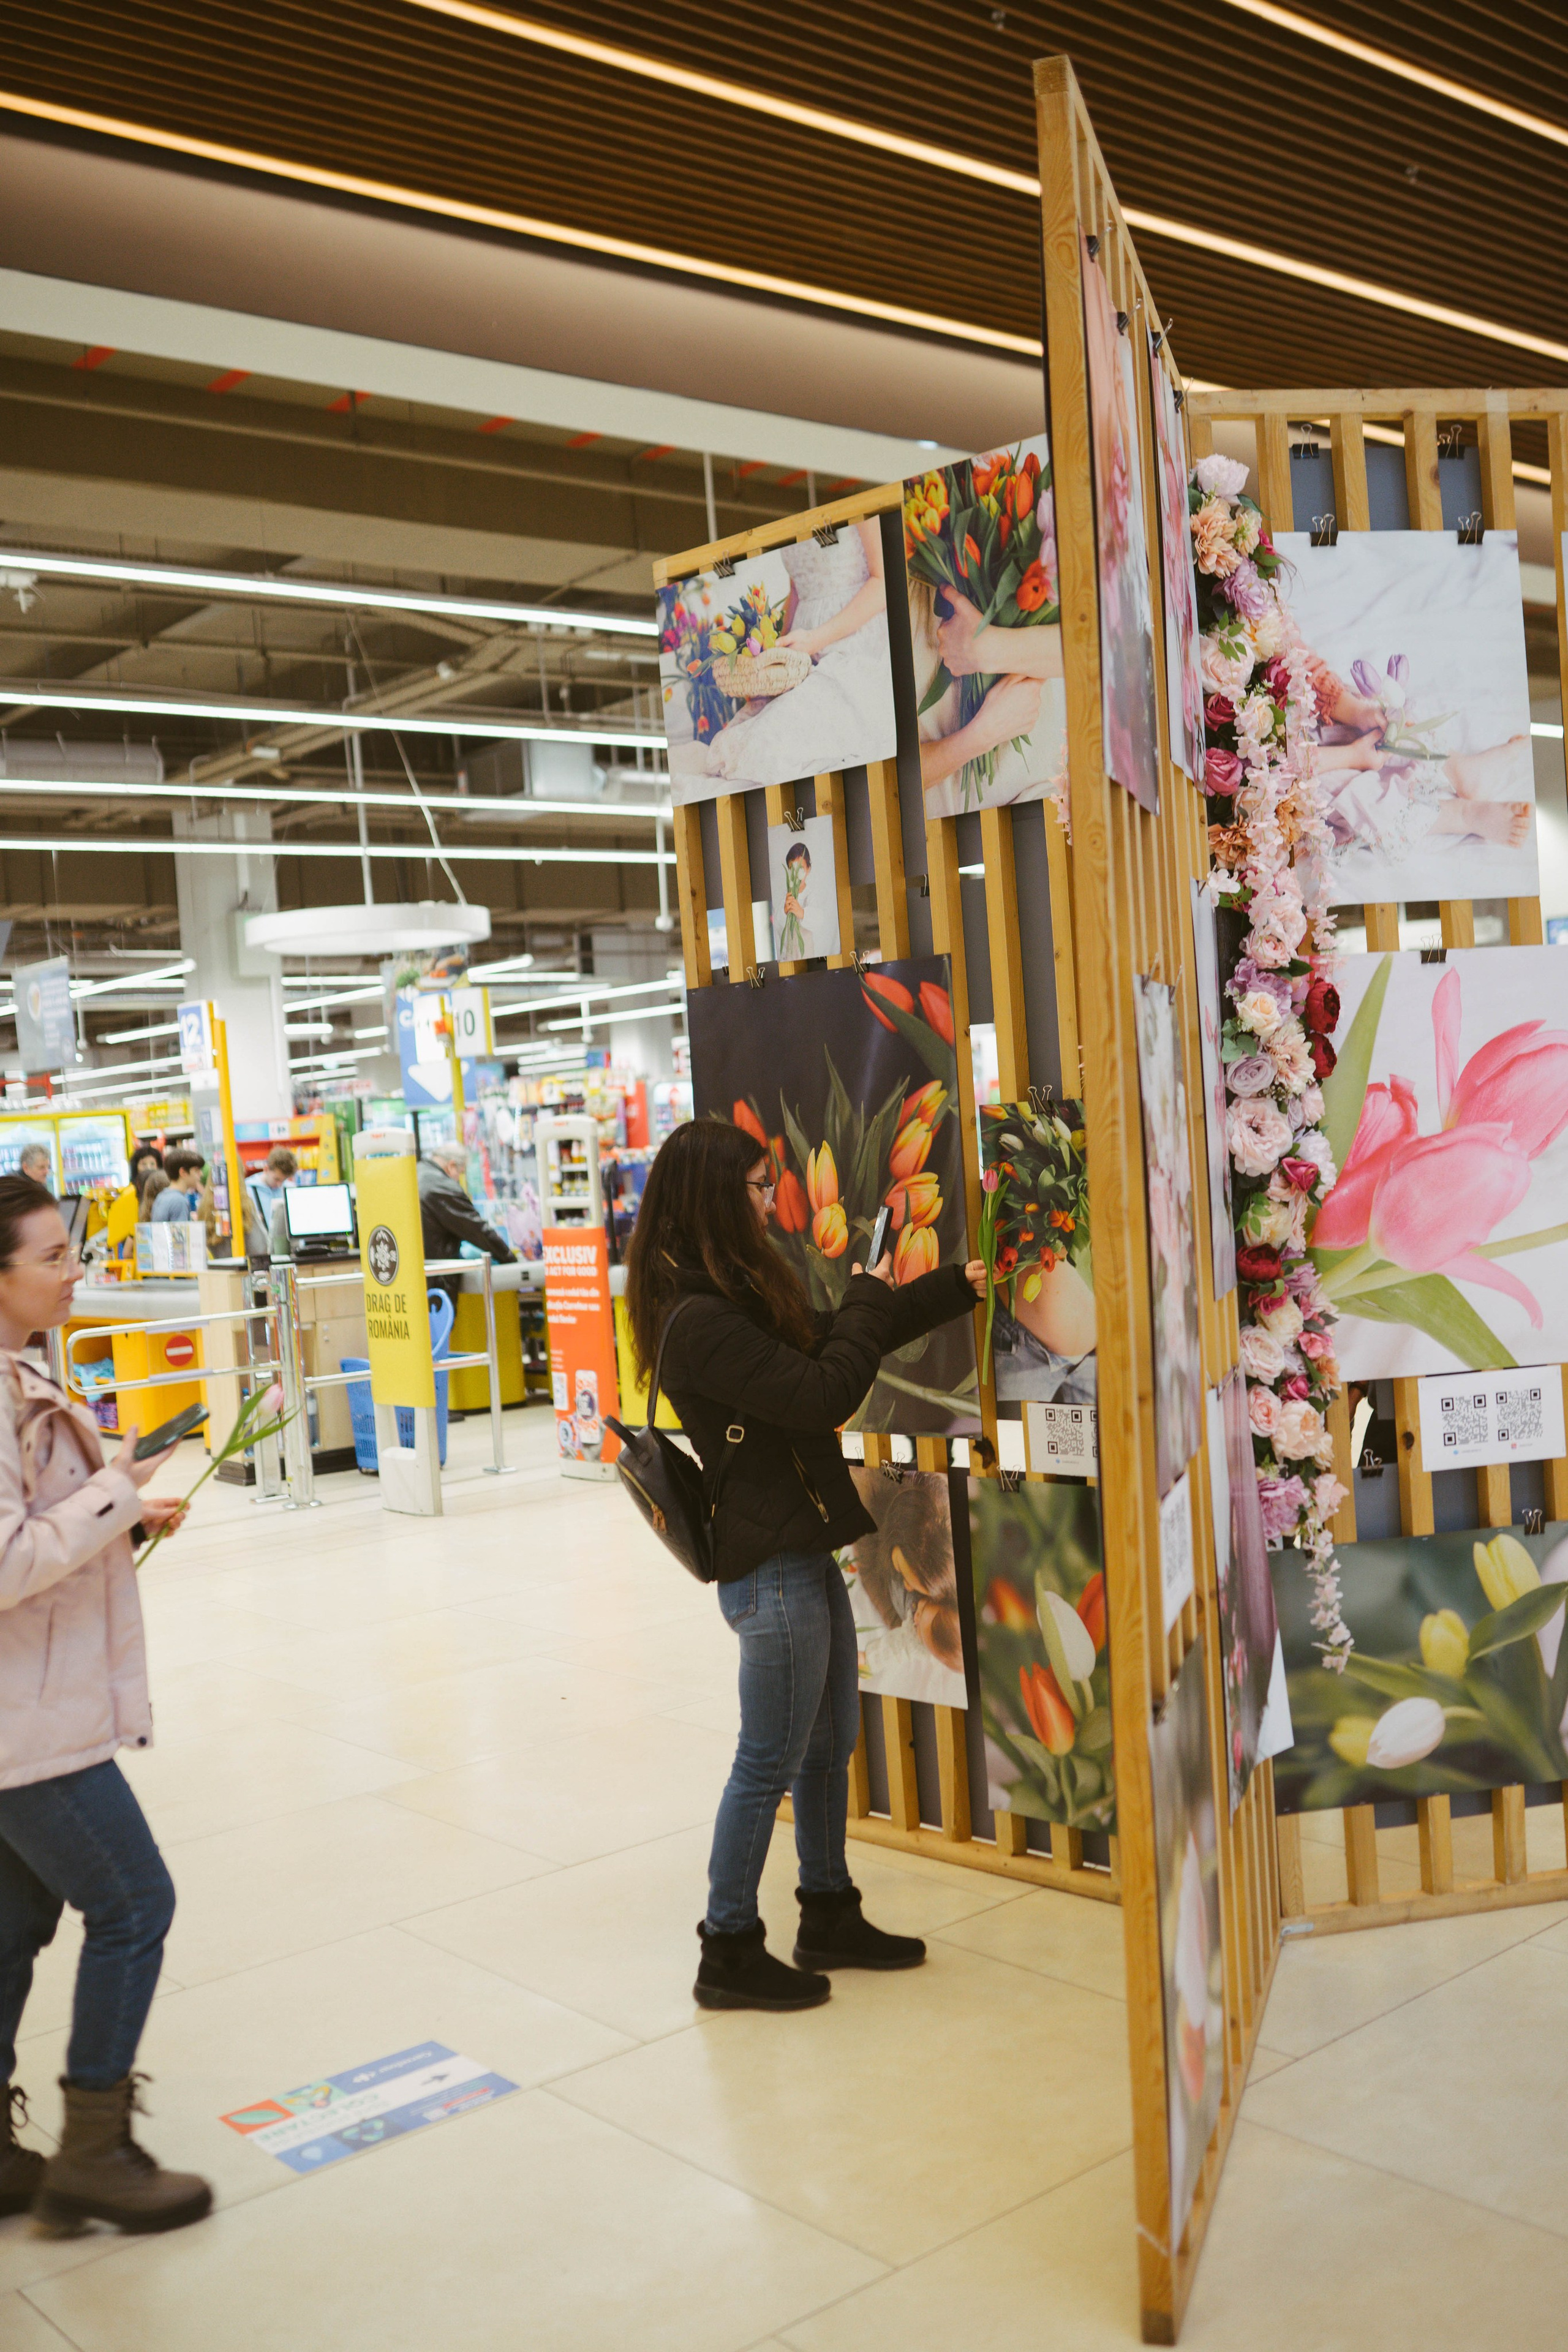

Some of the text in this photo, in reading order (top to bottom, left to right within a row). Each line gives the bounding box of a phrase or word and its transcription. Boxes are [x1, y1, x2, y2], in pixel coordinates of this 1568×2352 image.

[181, 1013, 201, 1047] 12
[366, 1294, 407, 1314] DRAG DE
[368, 1314, 410, 1340] ROMÂNIA
